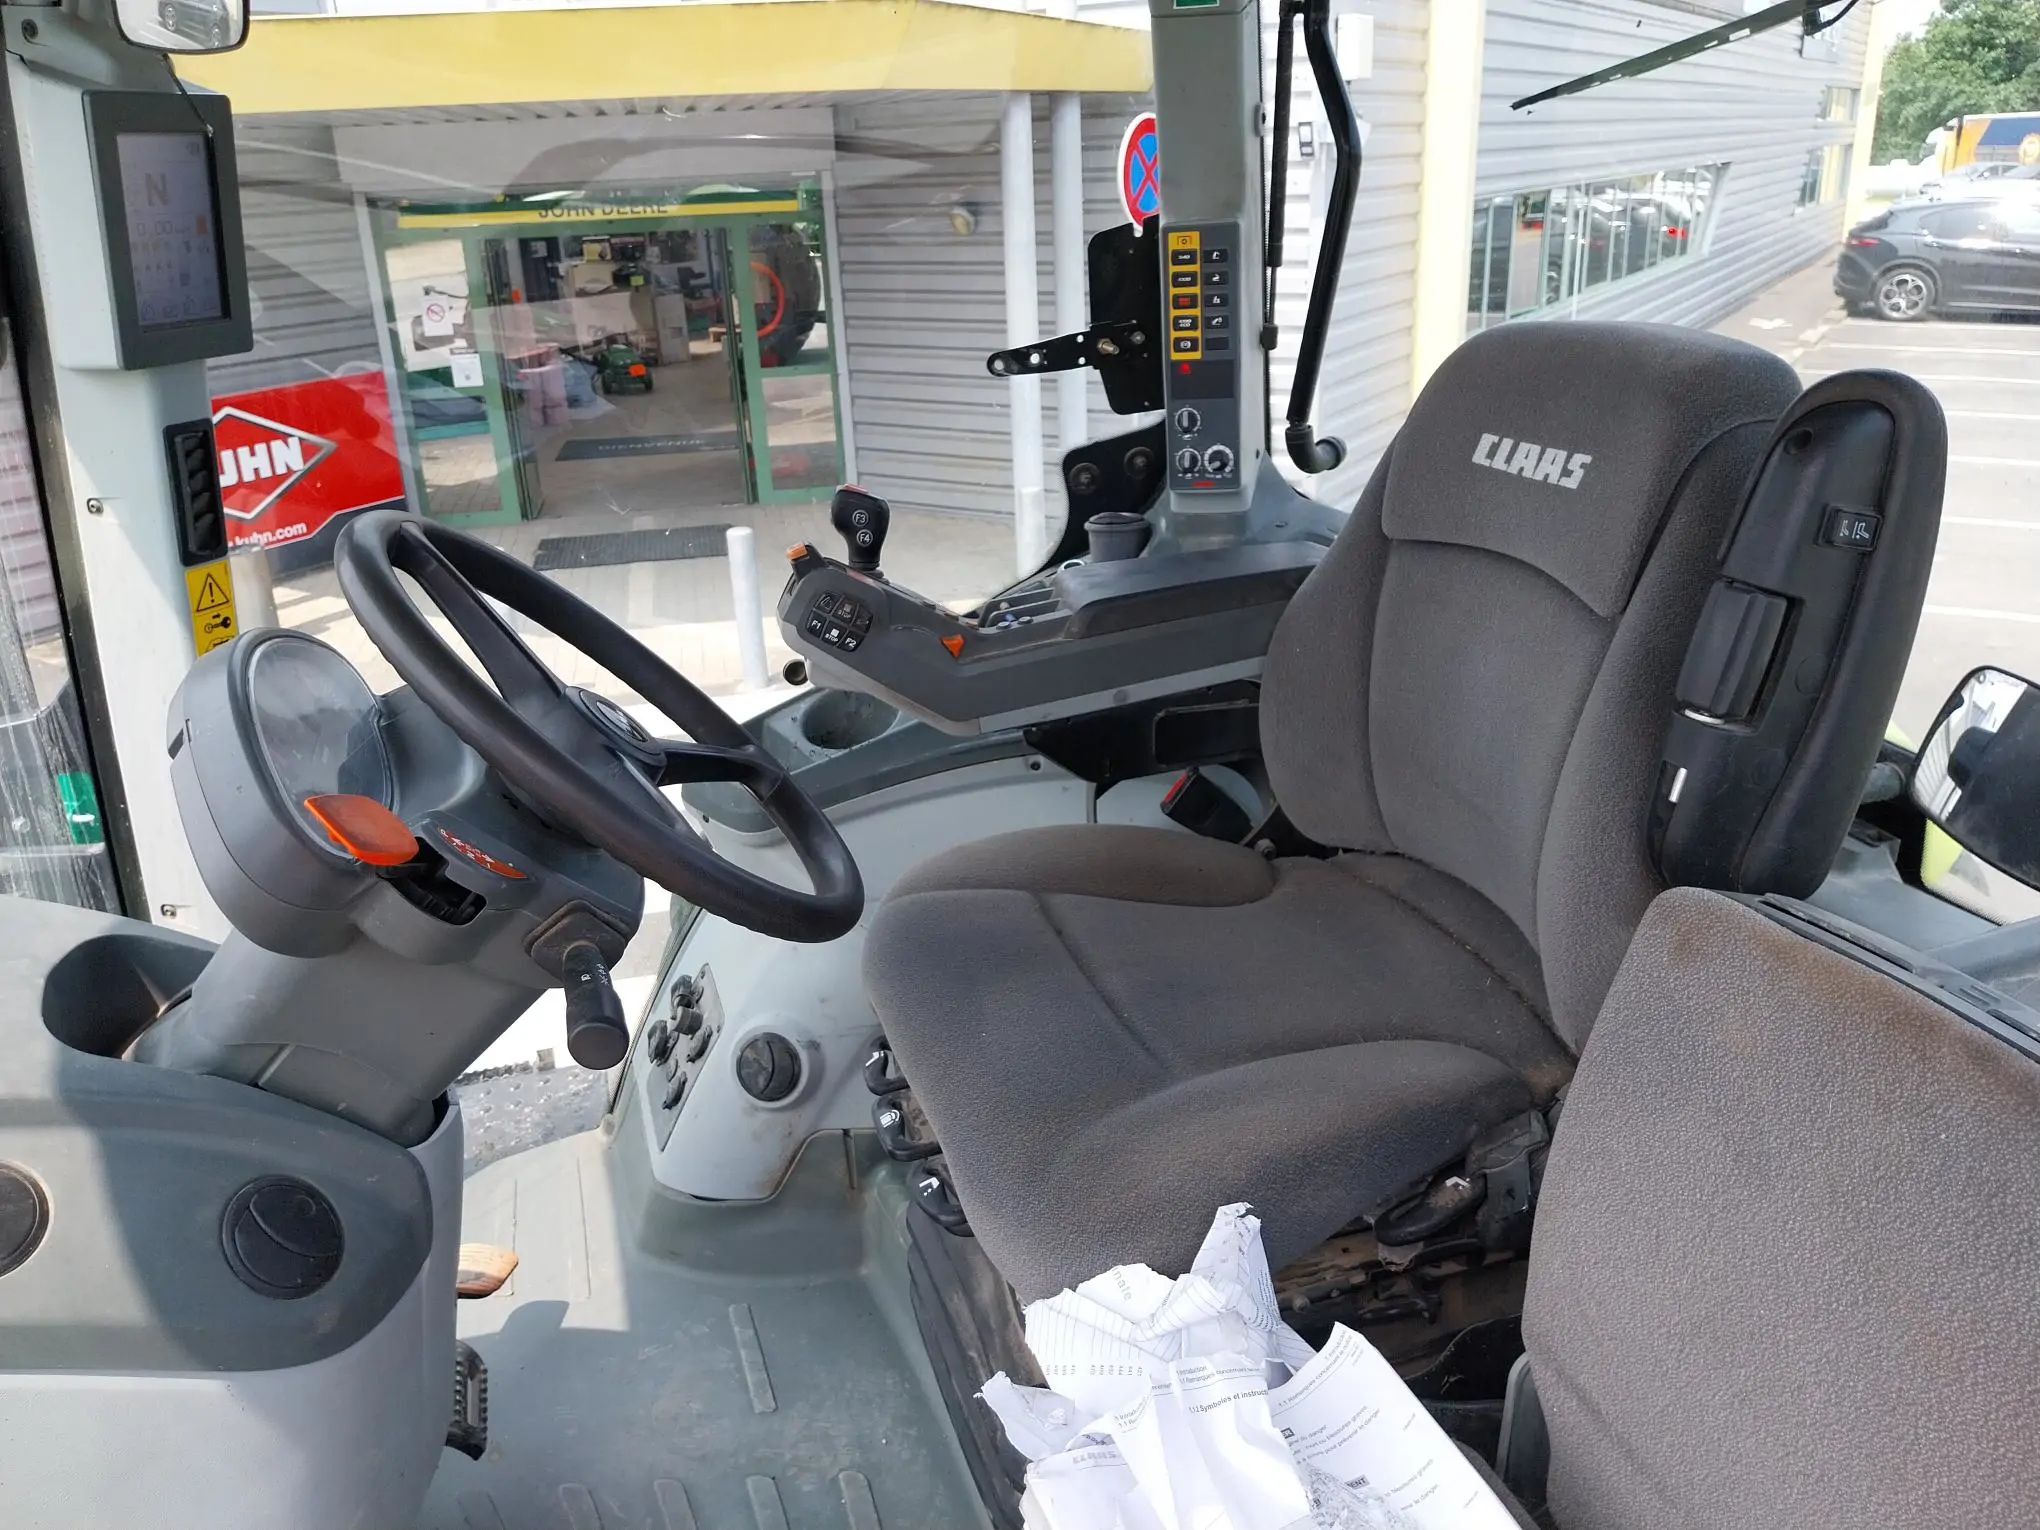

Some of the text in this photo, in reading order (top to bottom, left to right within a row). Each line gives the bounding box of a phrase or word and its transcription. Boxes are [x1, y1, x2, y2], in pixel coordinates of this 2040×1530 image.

[144, 172, 170, 207] N
[1472, 433, 1592, 489] CLAAS
[811, 619, 821, 629] F1
[824, 633, 839, 643] STOP
[845, 637, 857, 648] F2
[1200, 1396, 1232, 1413] Symboles
[1233, 1392, 1240, 1400] et
